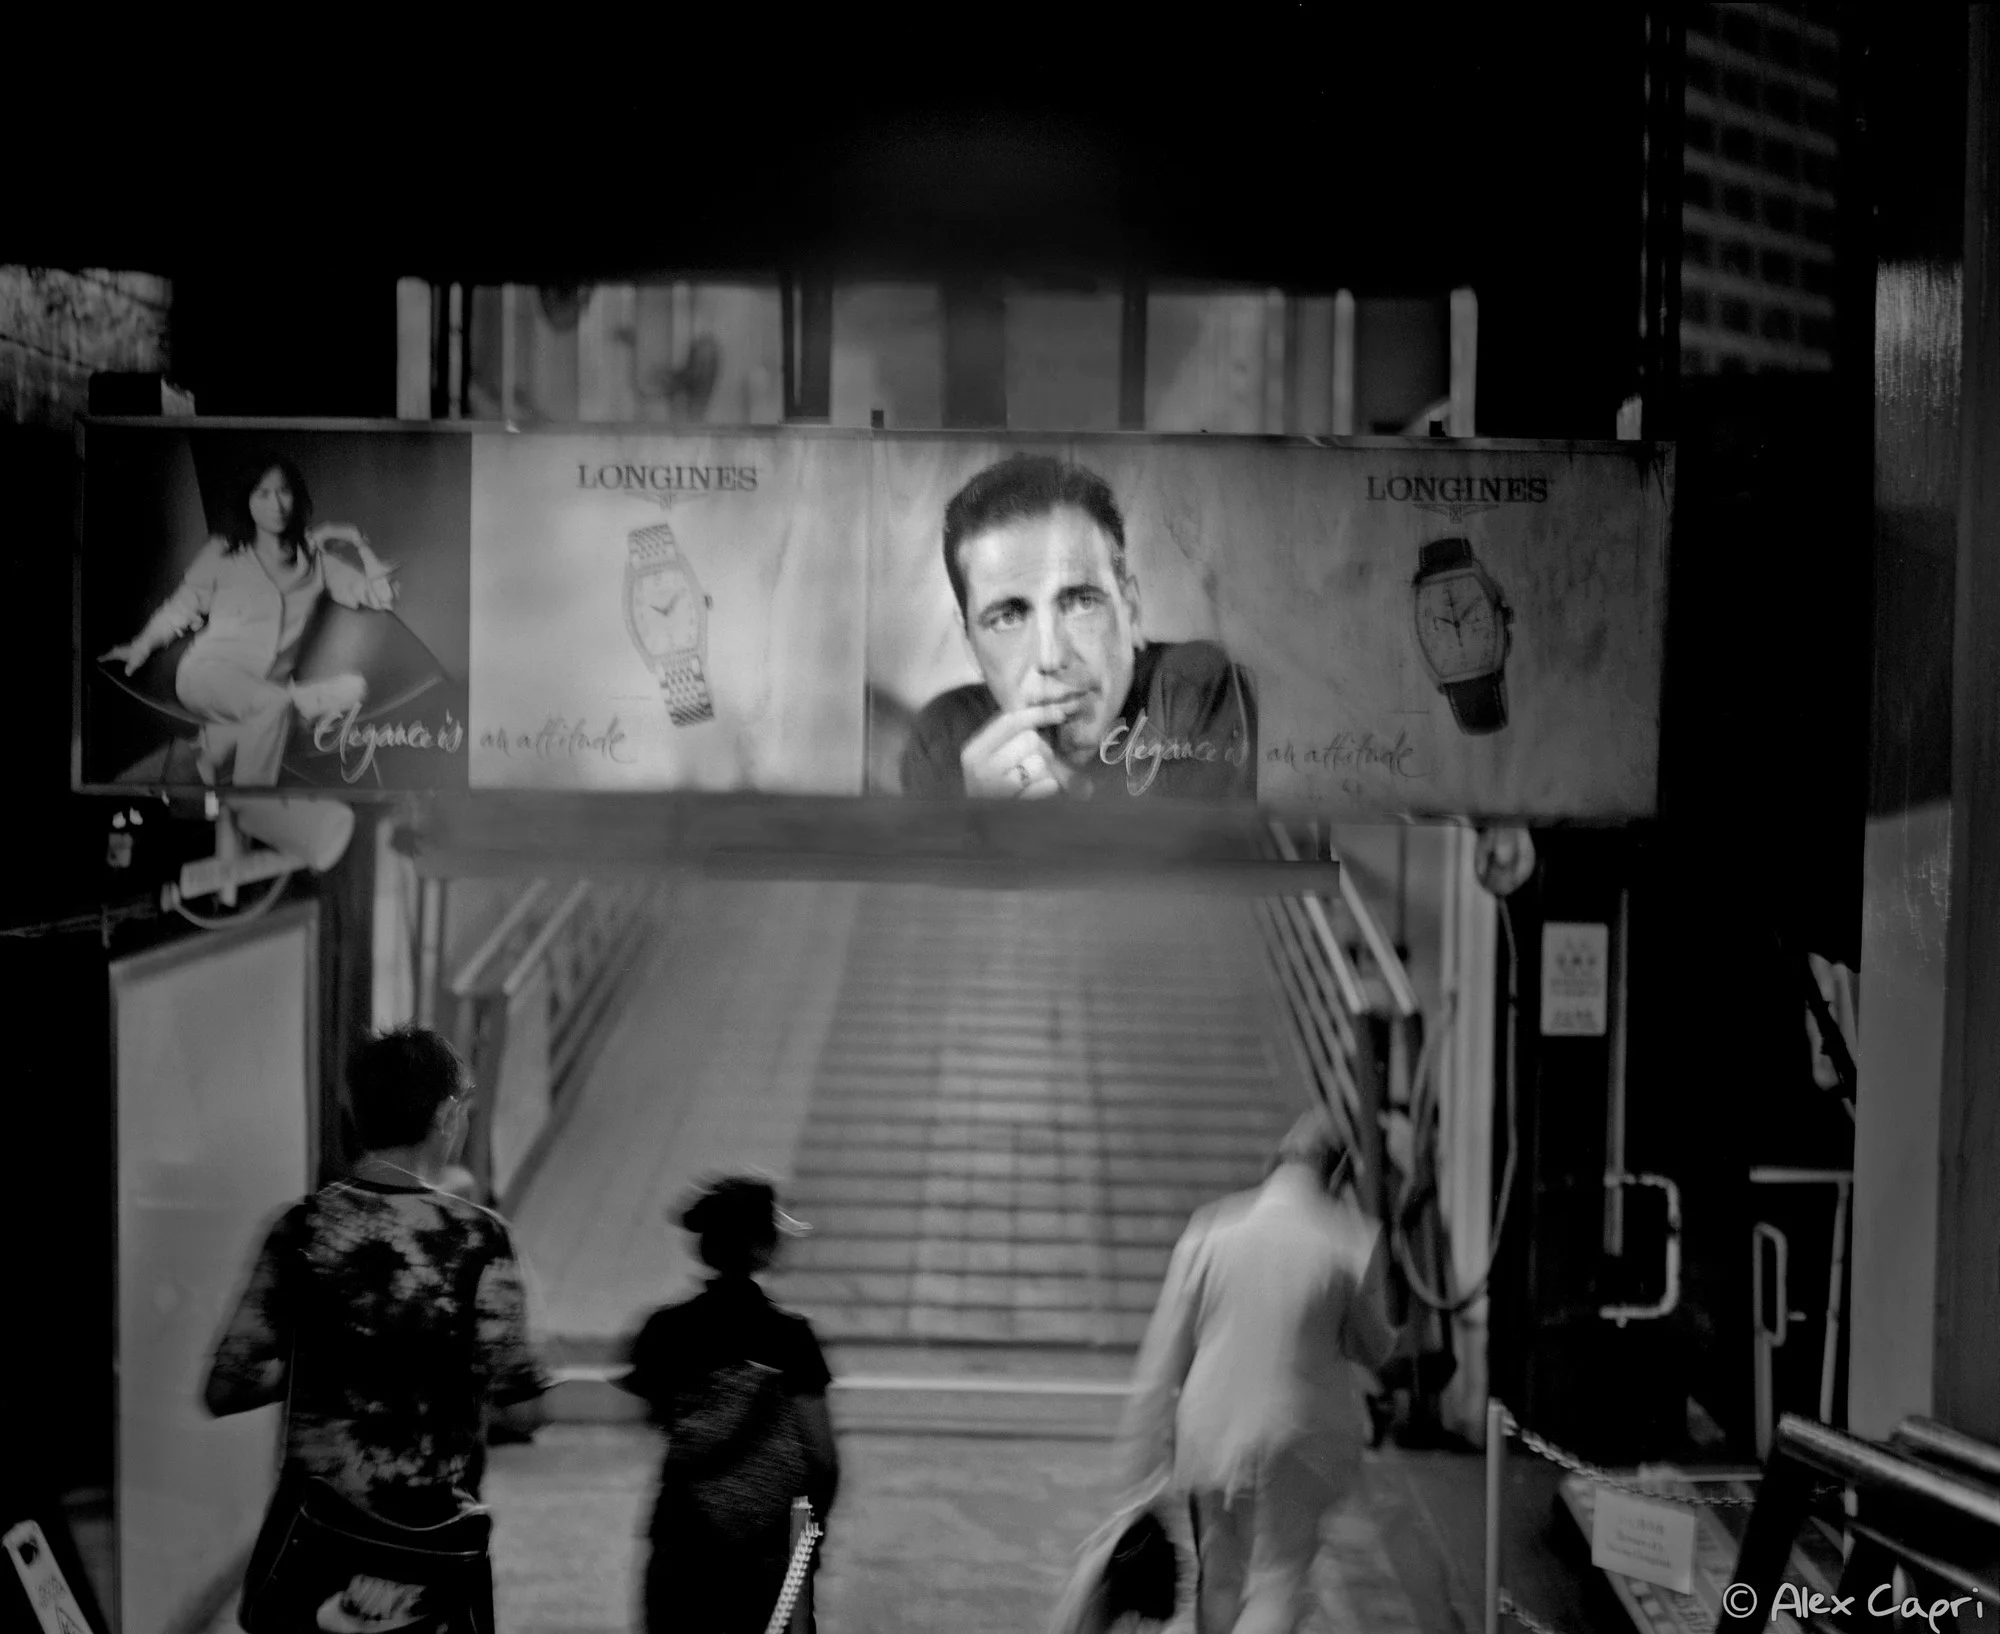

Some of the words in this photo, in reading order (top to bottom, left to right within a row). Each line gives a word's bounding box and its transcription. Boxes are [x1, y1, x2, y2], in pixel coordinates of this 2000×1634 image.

[577, 464, 760, 492] LONGINES
[1366, 475, 1549, 503] LONGINES
[313, 701, 433, 784] Elegance
[1100, 707, 1217, 797] Elegance
